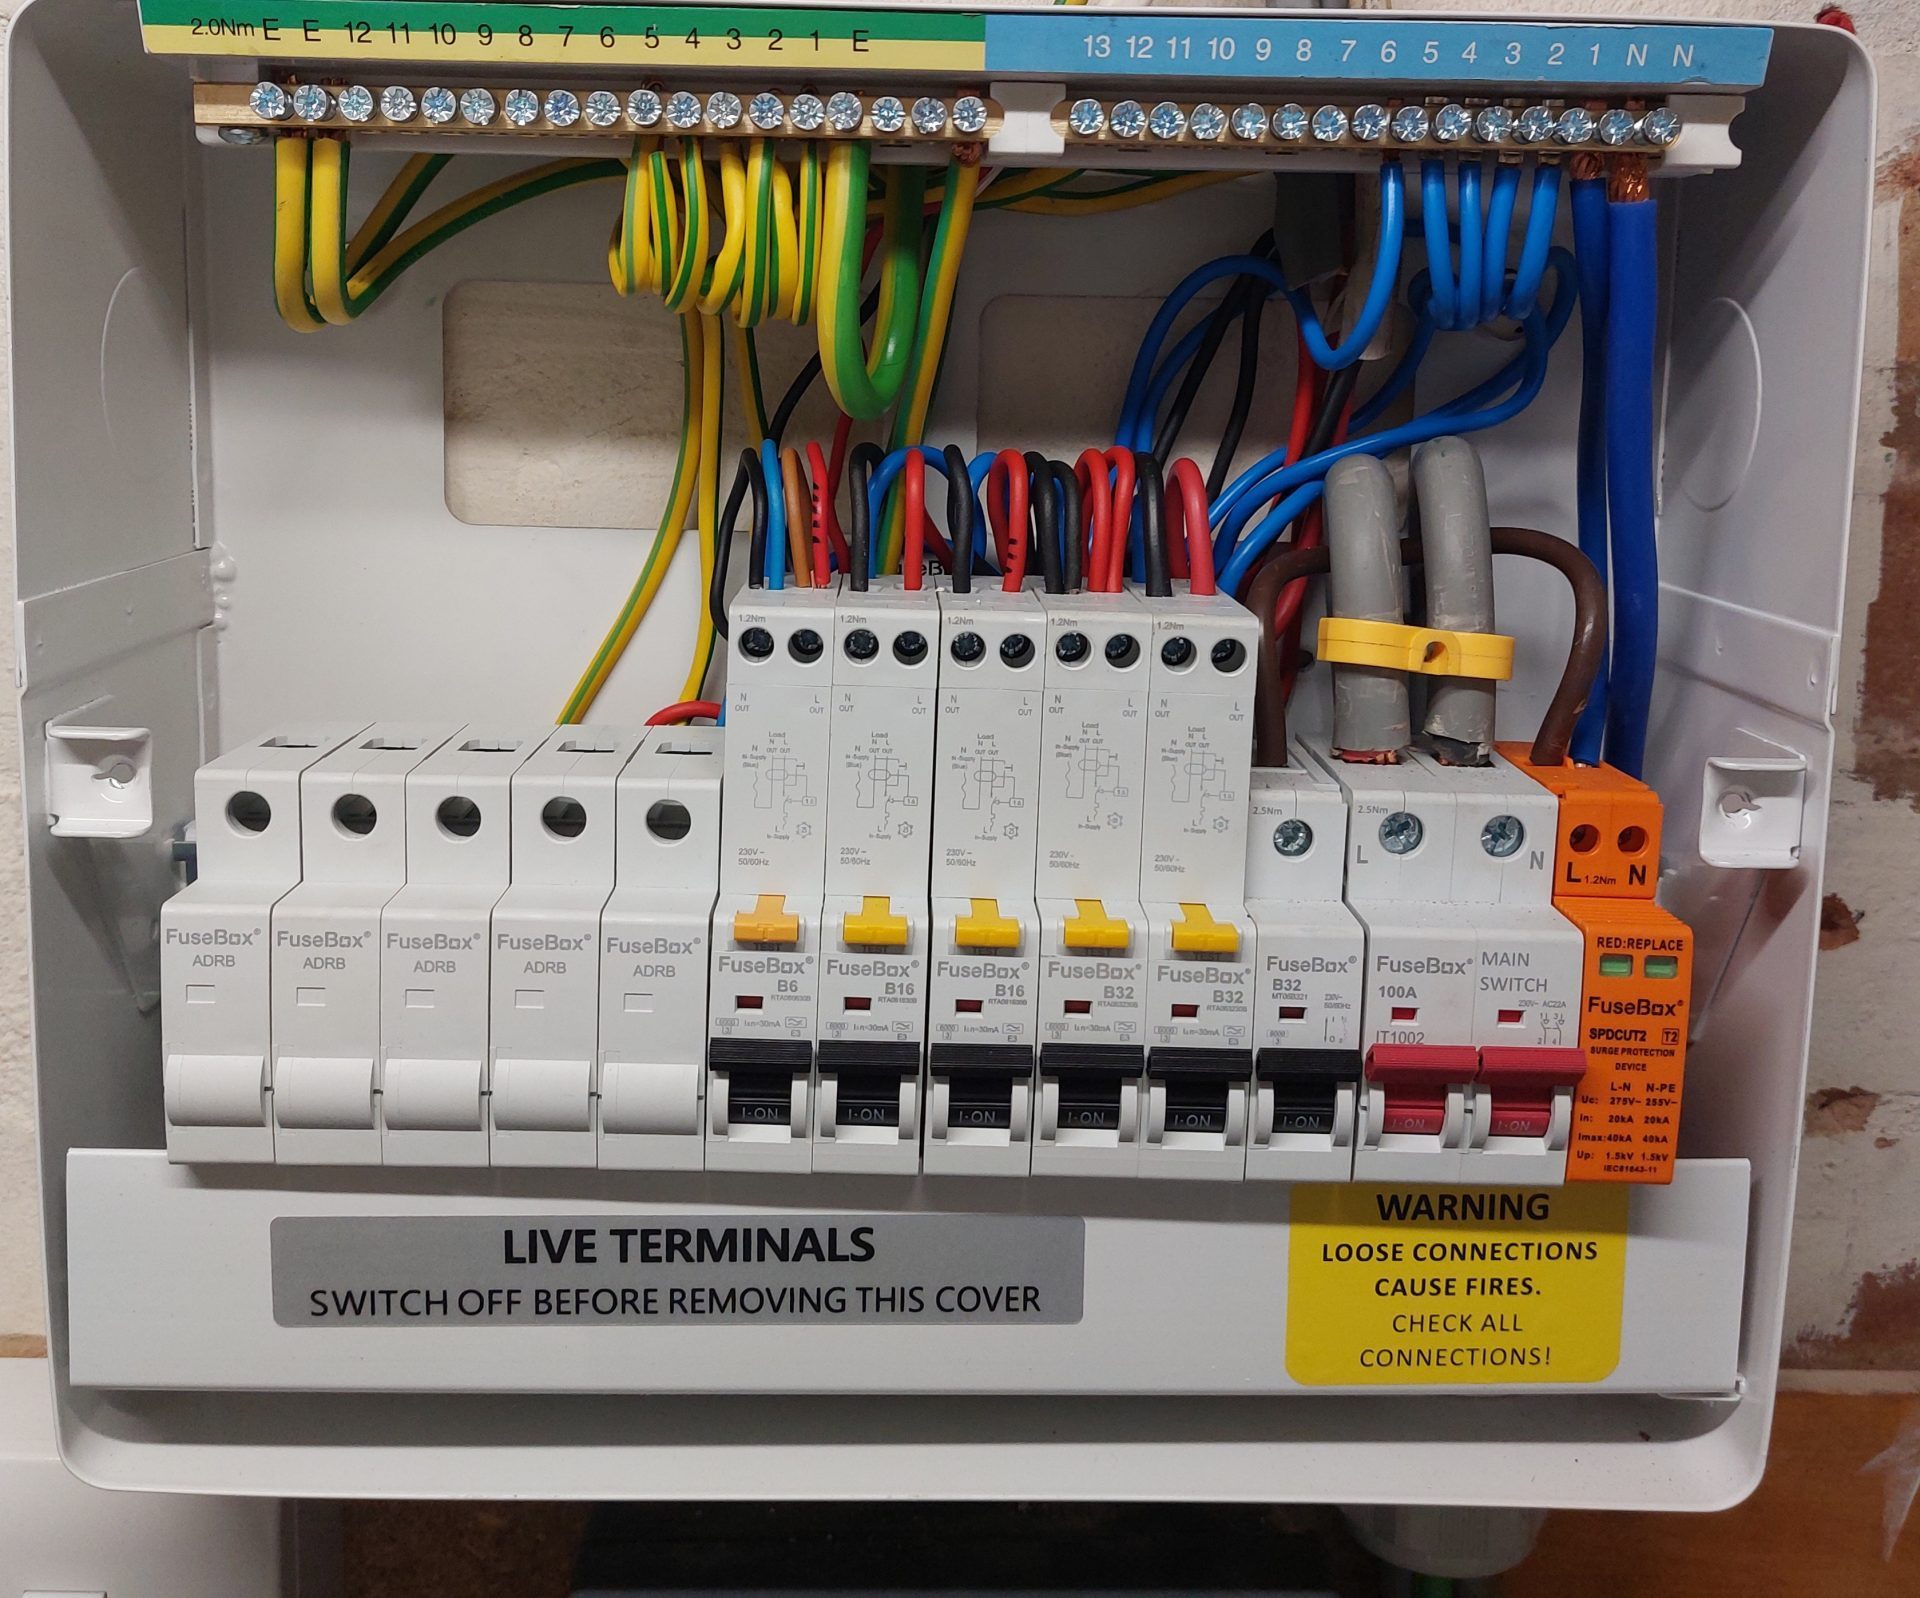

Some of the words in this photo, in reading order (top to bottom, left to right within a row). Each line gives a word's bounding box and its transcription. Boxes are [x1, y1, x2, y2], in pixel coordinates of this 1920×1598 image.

[190, 17, 256, 38] 2.0Nm
[262, 17, 282, 42] E
[302, 19, 322, 43] E
[342, 20, 374, 45] 12
[385, 21, 411, 45] 11
[428, 22, 457, 46] 10
[476, 23, 493, 46] 9
[518, 24, 534, 52] 8
[559, 24, 574, 52] 7
[600, 24, 615, 52] 6
[644, 24, 660, 52] 5
[685, 24, 700, 52] 4
[726, 24, 742, 52] 3
[767, 24, 783, 52] 2
[810, 24, 820, 52] 1
[852, 24, 870, 52] E
[1083, 34, 1110, 63] 13
[1126, 34, 1153, 63] 12
[1167, 34, 1191, 63] 11
[1208, 34, 1235, 63] 10
[1255, 34, 1272, 63] 9
[1296, 34, 1312, 63] 8
[1340, 34, 1356, 63] 7
[1380, 34, 1397, 63] 6
[1423, 40, 1440, 68] 5
[1461, 40, 1478, 68] 4
[1504, 40, 1521, 68] 3
[1547, 40, 1565, 68] 2
[1590, 40, 1599, 68] 1
[1625, 40, 1648, 68] N
[1672, 40, 1694, 68] N
[841, 615, 866, 623] 1.2Nm
[948, 617, 973, 625] 1.2Nm
[1051, 618, 1077, 626] 1.2Nm
[1157, 622, 1184, 630] 1.2Nm
[741, 693, 746, 701] N
[815, 695, 821, 703] L
[845, 693, 851, 702] N
[917, 696, 923, 704] L
[951, 695, 957, 703] N
[1024, 697, 1029, 705] L
[1055, 695, 1061, 704] N
[1128, 698, 1134, 707] L
[1161, 699, 1167, 707] N
[1235, 702, 1240, 711] L
[1251, 806, 1282, 816] 2.5Nm
[1358, 805, 1388, 814] 2.5Nm
[1357, 845, 1368, 864] L
[1530, 851, 1544, 870] N
[1567, 862, 1581, 882] L
[1585, 875, 1616, 884] 1.2Nm
[1629, 864, 1646, 885] N
[1597, 937, 1683, 951] RED:REPLACE
[193, 955, 235, 967] ADRB
[303, 957, 345, 969] ADRB
[1482, 952, 1529, 966] MAIN
[414, 961, 456, 973] ADRB
[524, 961, 566, 974] ADRB
[633, 965, 675, 977] ADRB
[778, 980, 798, 992] B6
[885, 982, 914, 995] B16
[996, 984, 1024, 997] B16
[1273, 979, 1301, 991] B32
[1480, 977, 1547, 992] SWITCH
[1104, 986, 1134, 999] B32
[1213, 990, 1243, 1003] B32
[1379, 986, 1417, 998] 100A
[1543, 1000, 1566, 1008] AC22A
[1375, 1031, 1424, 1045] IT1002
[1589, 1028, 1646, 1041] SPDCUT2
[1664, 1031, 1678, 1042] T2
[1591, 1046, 1619, 1055] SURGE
[1621, 1048, 1675, 1057] PROTECTION
[1615, 1063, 1646, 1071] DEVICE
[1611, 1082, 1630, 1091] L-N
[1646, 1083, 1675, 1093] N-PE
[1580, 1095, 1598, 1104] Uc:
[1609, 1115, 1633, 1123] 20kA
[1644, 1116, 1669, 1124] 20kA
[1607, 1134, 1632, 1142] 40kA
[1643, 1135, 1668, 1143] 40kA
[1606, 1152, 1633, 1160] 1.5kV
[1642, 1153, 1668, 1161] 1.5kV
[1377, 1193, 1549, 1220] WARNING
[505, 1229, 597, 1264] LIVE
[610, 1227, 875, 1263] TERMINALS
[1323, 1244, 1403, 1261] LOOSE
[1413, 1242, 1597, 1261] CONNECTIONS
[1375, 1278, 1456, 1296] CAUSE
[1467, 1277, 1540, 1295] FIRES.
[311, 1290, 447, 1316] SWITCH
[458, 1289, 521, 1315] OFF
[535, 1289, 658, 1315] BEFORE
[670, 1287, 845, 1314] REMOVING
[856, 1287, 924, 1312] THIS
[936, 1286, 1040, 1312] COVER
[1393, 1314, 1471, 1332] CHECK
[1481, 1314, 1522, 1331] ALL
[1360, 1347, 1549, 1367] CONNECTIONS!
